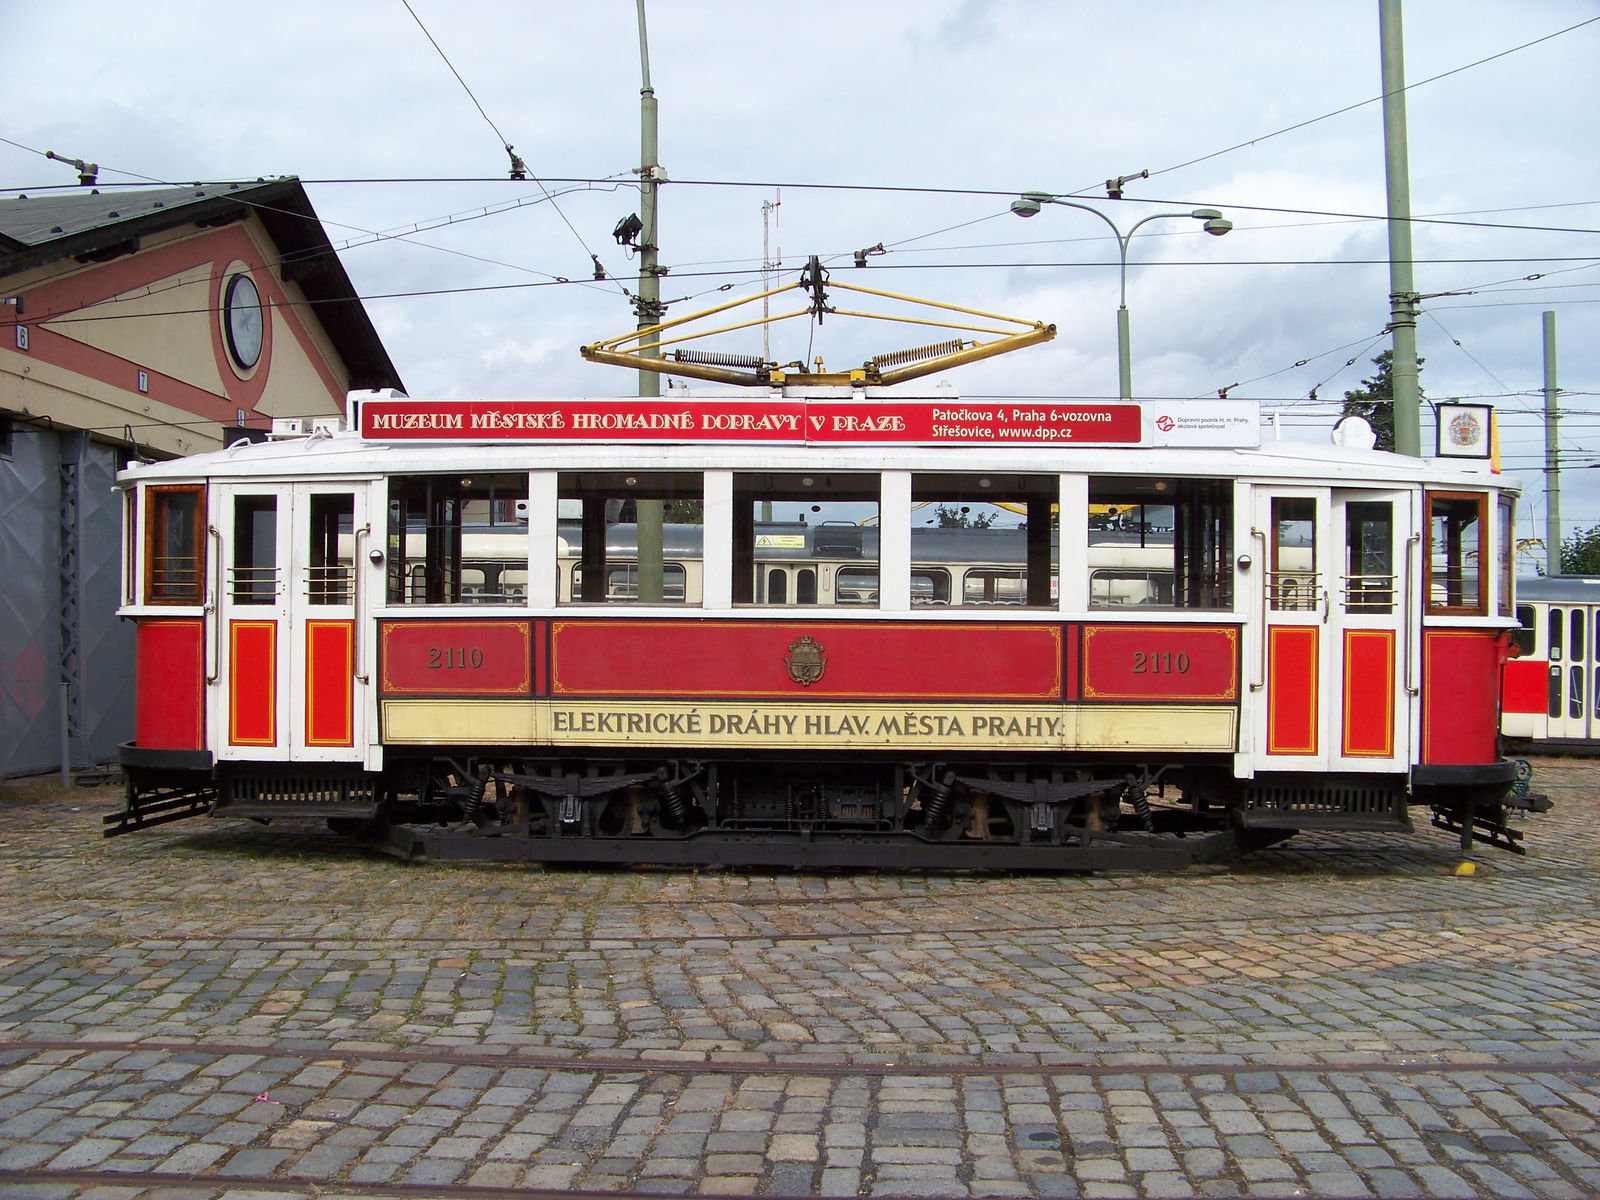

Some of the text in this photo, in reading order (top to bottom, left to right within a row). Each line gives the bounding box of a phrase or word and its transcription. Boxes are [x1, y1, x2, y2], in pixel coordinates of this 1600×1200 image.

[372, 410, 906, 433] MUZEUM MĚSTSKÉ HROMADNÉ DOPRAVY V PRAZE
[932, 407, 1112, 424] Patočkova 4, Praha 6-vozovna
[1201, 417, 1218, 425] podnik
[1233, 417, 1250, 425] Prahy,
[931, 423, 1073, 441] Střešovice, www.dpp.cz
[427, 647, 484, 670] 2110
[1132, 651, 1191, 674] 2110
[553, 708, 702, 735] ELEKTRICKÉ
[709, 709, 798, 736] DRÁHY
[804, 714, 870, 737] HLAV.
[875, 711, 965, 738] MĚSTA
